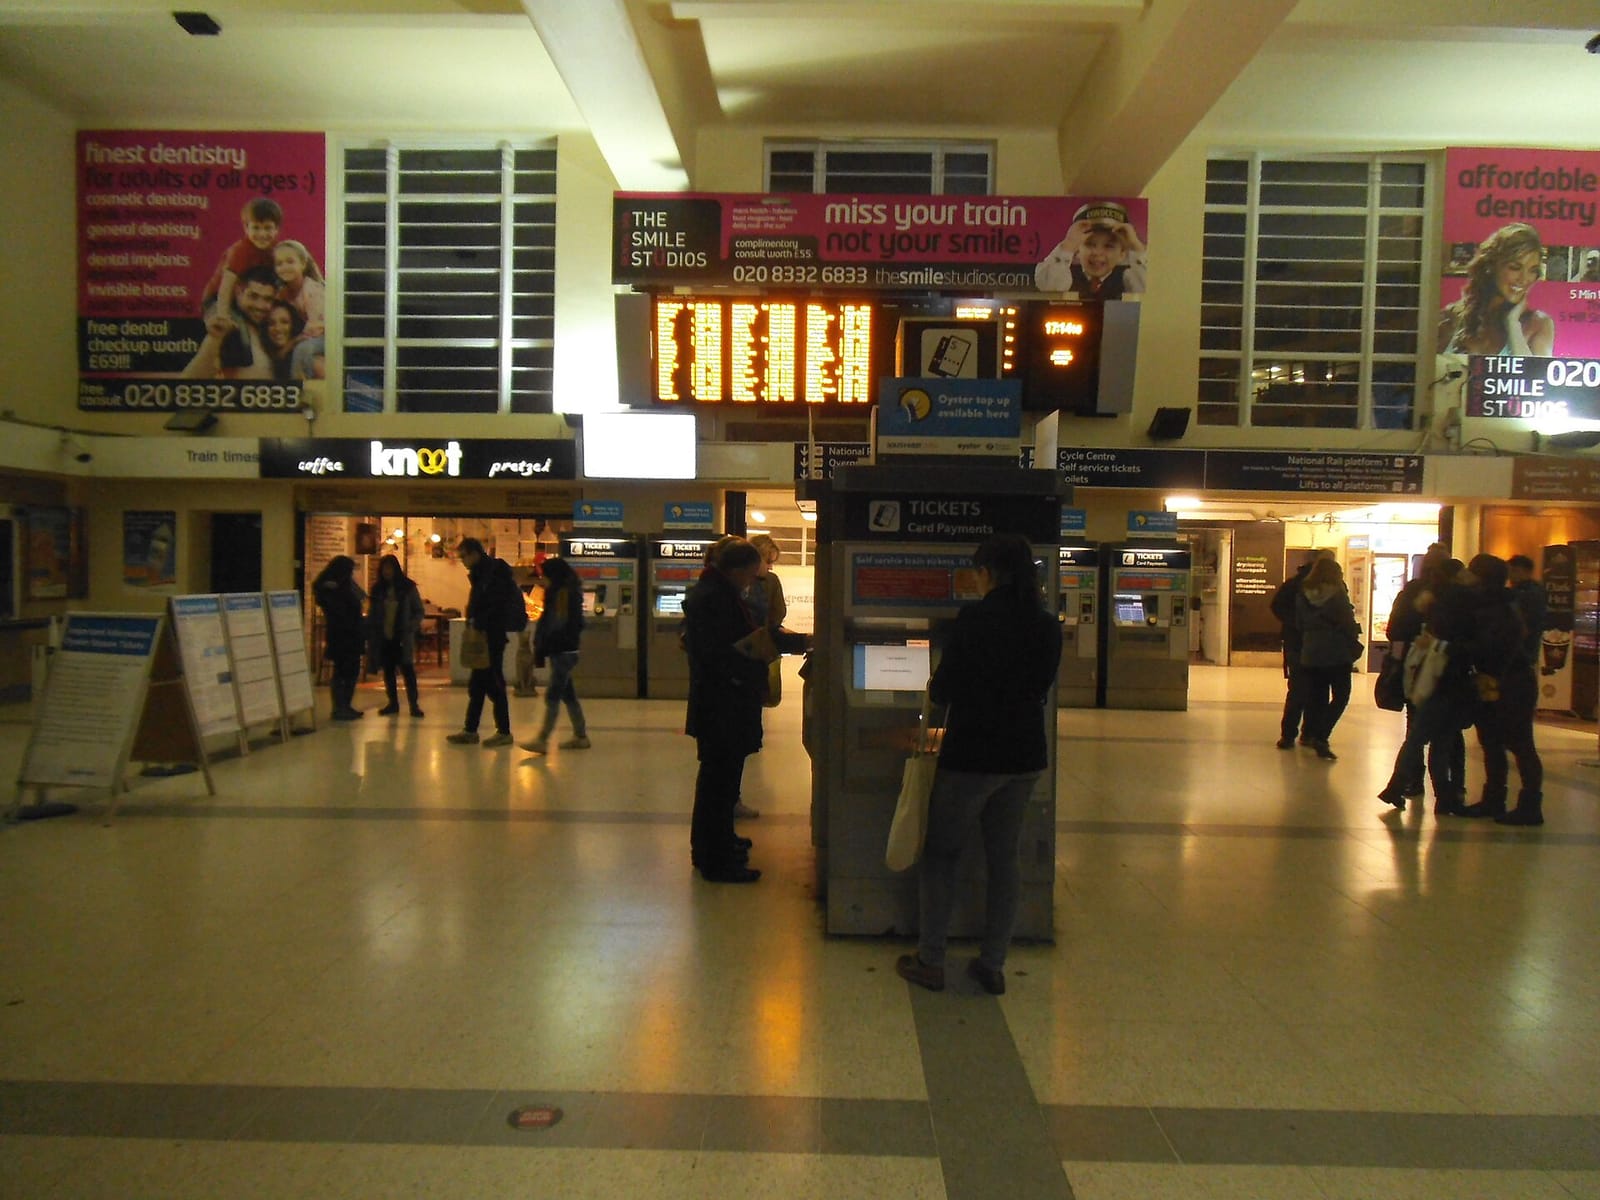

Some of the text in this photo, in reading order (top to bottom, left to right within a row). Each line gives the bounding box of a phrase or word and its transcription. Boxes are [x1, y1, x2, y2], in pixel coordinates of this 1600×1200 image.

[85, 142, 247, 170] finest dentistry
[119, 170, 183, 190] adults
[189, 171, 212, 190] of
[216, 172, 243, 190] all
[247, 174, 298, 194] ages
[1459, 163, 1597, 192] affordable
[146, 193, 208, 209] dentistry
[631, 211, 668, 227] THE
[825, 197, 1028, 231] miss your train
[1476, 194, 1597, 227] dentistry
[86, 222, 202, 240] general dentistry
[631, 231, 686, 248] SMILE
[735, 238, 799, 250] complimentary
[826, 229, 874, 253] not
[878, 232, 940, 257] your
[948, 229, 1021, 255] smile
[87, 253, 191, 270] dental implants
[735, 249, 766, 259] consult
[767, 249, 793, 259] worth
[733, 265, 1031, 290] 020 8332 6833 thesmilestudios.com
[87, 283, 188, 297] invisible braces
[1569, 289, 1577, 300] 5
[120, 319, 169, 336] dental
[87, 337, 199, 356] checkup worth
[1485, 357, 1525, 374] THE
[1547, 360, 1600, 389] 020
[1483, 378, 1546, 397] SMILE
[124, 384, 301, 409] 020 8332 6833
[938, 394, 1011, 409] Oyster top up
[938, 407, 1010, 420] available here
[187, 449, 260, 463] Train times
[828, 447, 866, 456] National
[1060, 451, 1117, 462] Cycle Centre
[297, 456, 345, 475] coffee
[1060, 462, 1142, 474] Self service tickets
[1288, 456, 1326, 466] National
[1327, 457, 1343, 466] Rail
[1345, 457, 1384, 469] platform
[1299, 480, 1386, 492] Lifts to all platforms
[908, 500, 982, 517] TICKETS
[907, 522, 995, 536] Card Payments
[856, 556, 873, 565] Self
[875, 557, 904, 566] service
